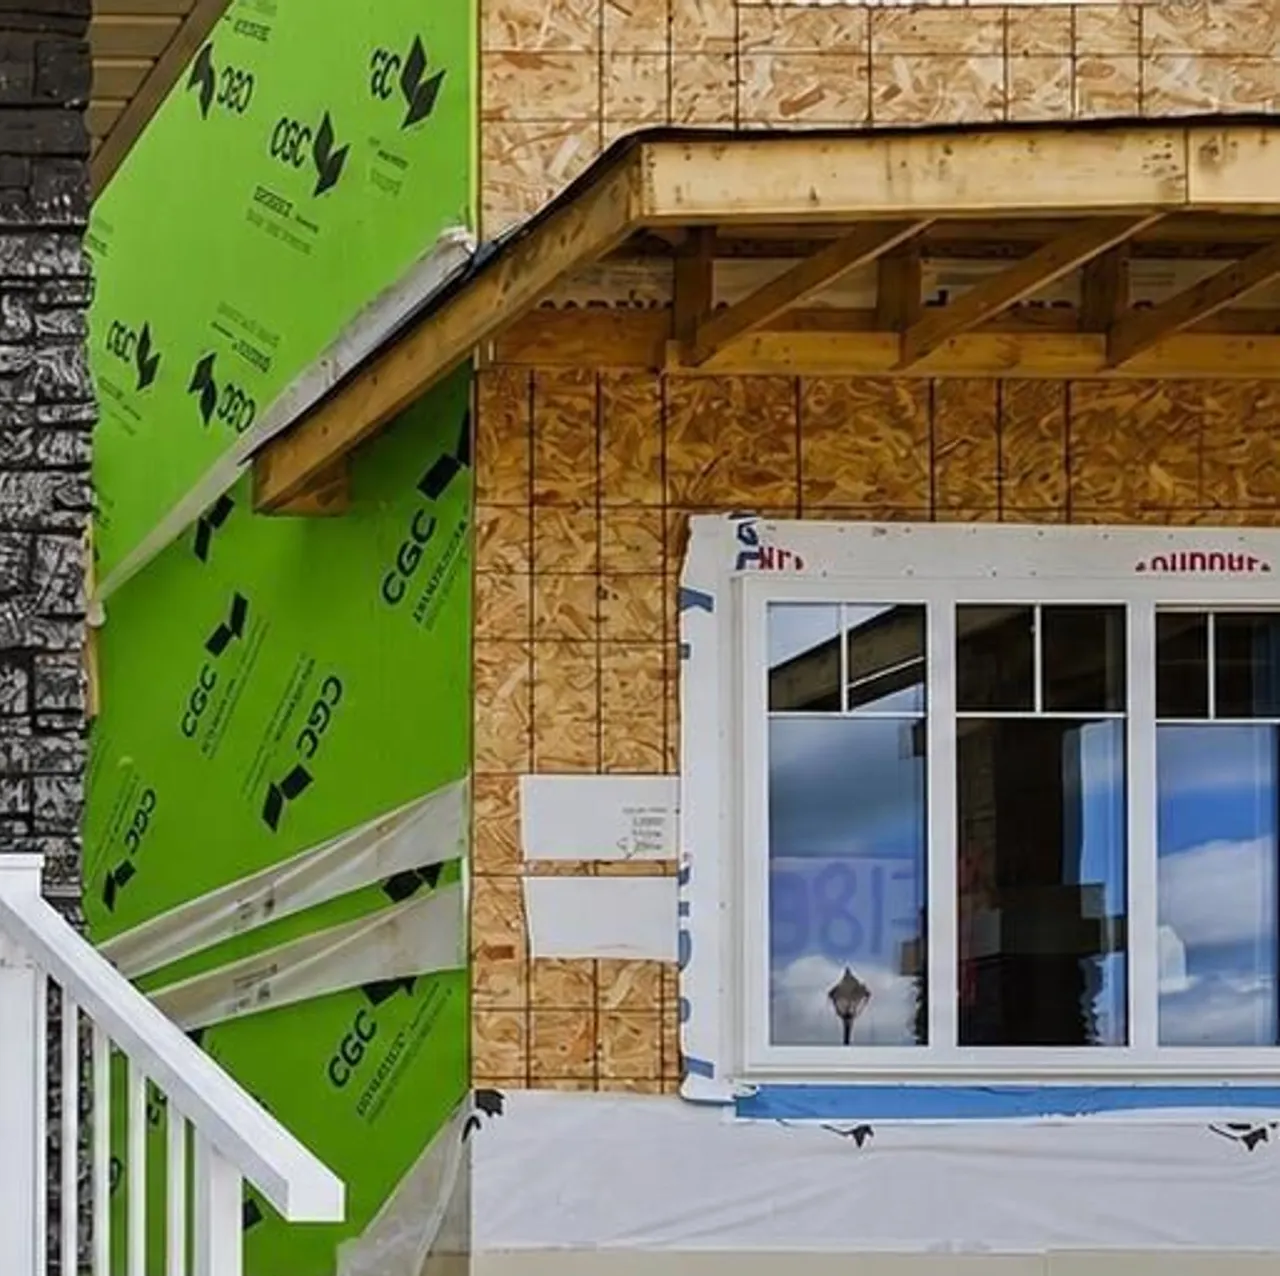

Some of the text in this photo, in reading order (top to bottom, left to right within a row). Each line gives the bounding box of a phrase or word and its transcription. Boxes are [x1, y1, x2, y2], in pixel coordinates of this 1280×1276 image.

[271, 117, 312, 168] CGC
[381, 509, 437, 605] CGC
[181, 664, 218, 738] CGC
[296, 676, 343, 759] CGC
[124, 788, 156, 854] CGC
[329, 1009, 377, 1088] CGC
